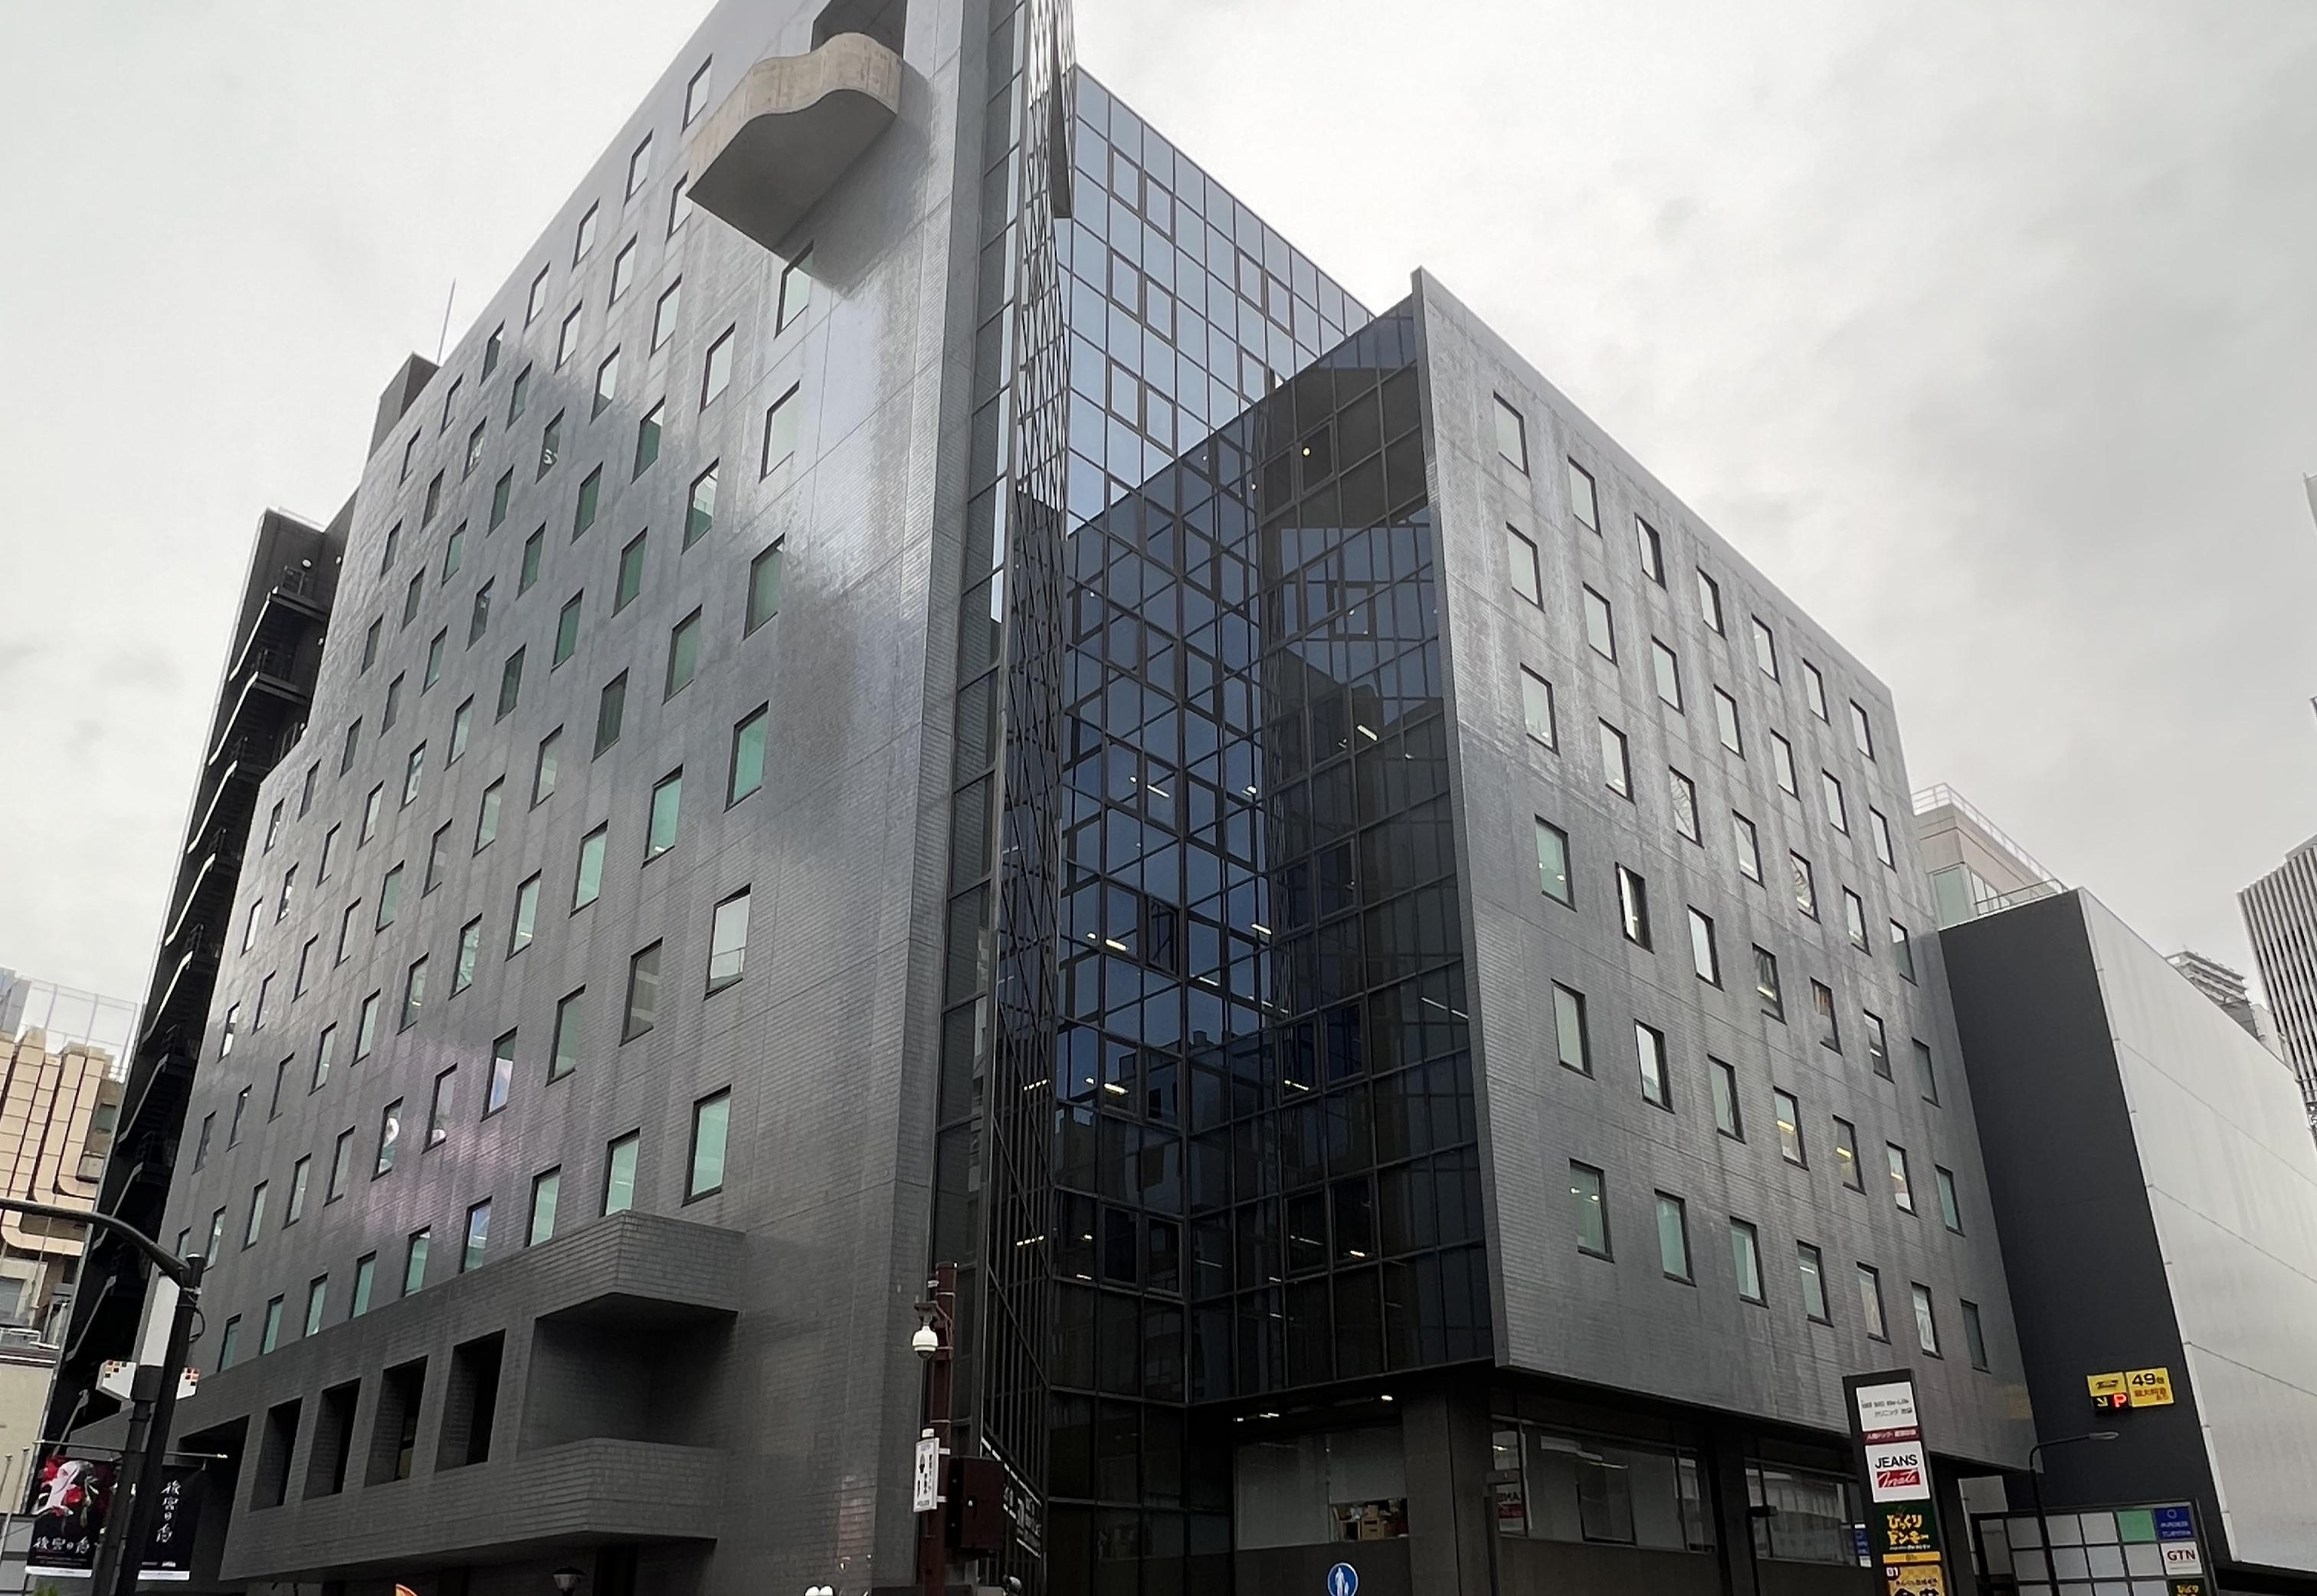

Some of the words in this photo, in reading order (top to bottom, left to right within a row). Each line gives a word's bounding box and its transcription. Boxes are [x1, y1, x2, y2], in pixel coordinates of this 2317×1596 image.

[2113, 1394, 2127, 1408] P
[1875, 1454, 1918, 1468] JEANS
[1886, 1512, 1923, 1530] びっくり
[1887, 1529, 1929, 1546] ドンキー
[2167, 1549, 2196, 1562] GTN
